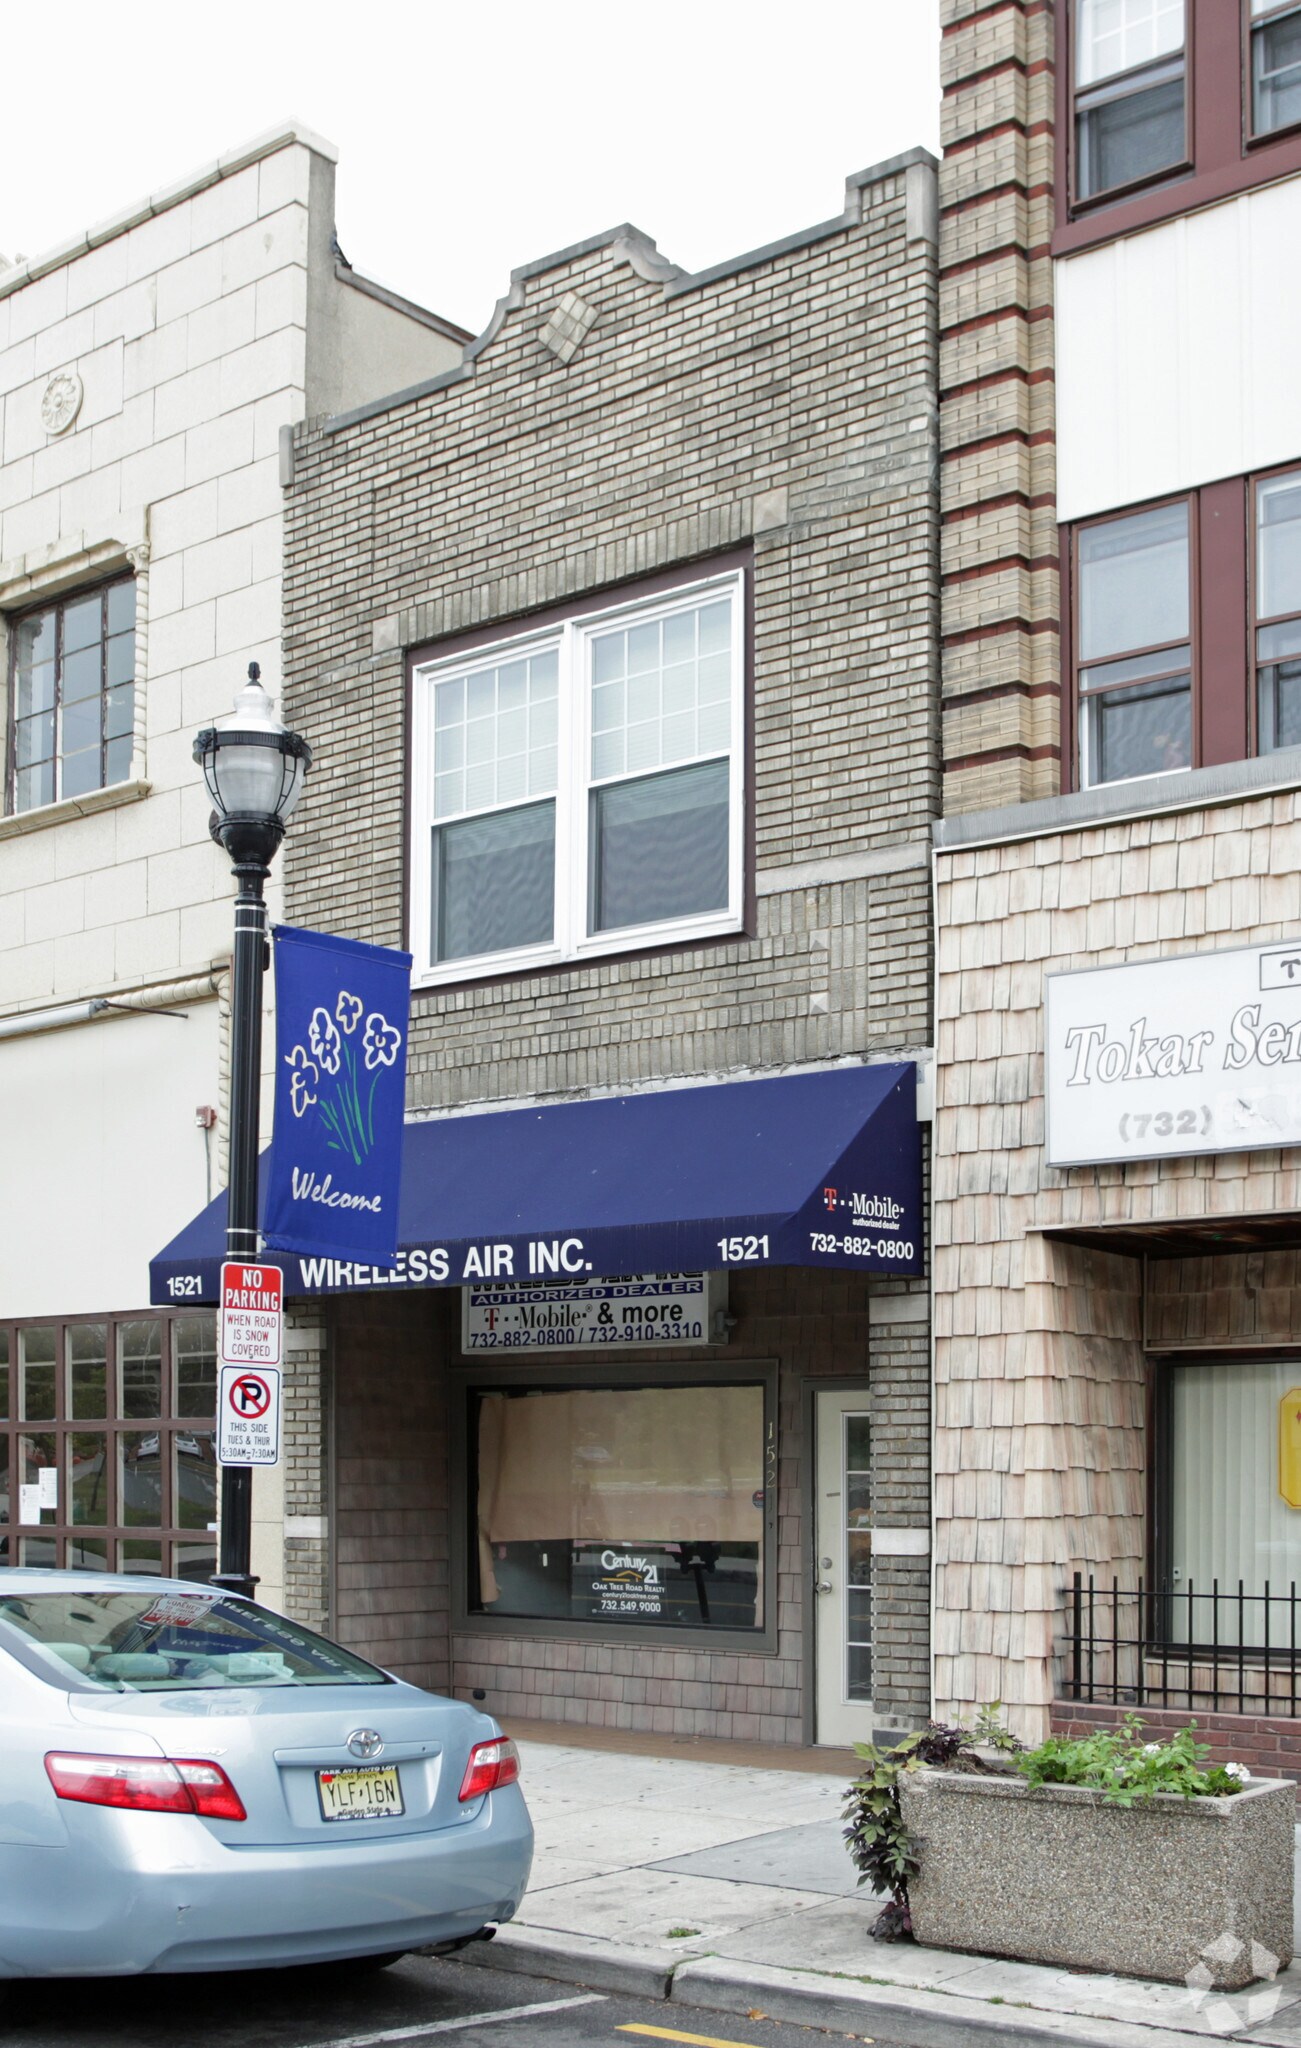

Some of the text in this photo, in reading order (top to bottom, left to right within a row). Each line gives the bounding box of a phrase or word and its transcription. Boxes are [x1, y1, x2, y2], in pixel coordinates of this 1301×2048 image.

[1065, 1017, 1214, 1088] Tokar
[1119, 1104, 1213, 1143] (732)
[292, 1166, 382, 1213] Welcome
[852, 1217, 900, 1231] authorized dealer
[462, 1243, 514, 1279] AIR
[528, 1238, 593, 1275] INC.
[717, 1234, 770, 1262] 1521
[809, 1232, 914, 1260] 732-882-0800
[166, 1275, 203, 1297] 1521
[242, 1269, 263, 1289] NO
[225, 1288, 278, 1311] PARKING
[475, 1287, 606, 1306] AUTHORIZED
[613, 1281, 701, 1298] DEALER
[227, 1313, 277, 1329] WHEN ROAD
[597, 1302, 614, 1326] &
[622, 1303, 683, 1324] more
[233, 1329, 269, 1342] IS SNOW
[470, 1327, 575, 1348] 732-882-0800
[588, 1321, 702, 1343] 732-910-3310
[231, 1343, 271, 1357] COVERED
[230, 1422, 269, 1433] THIS SIDE
[228, 1434, 244, 1445] TUES
[254, 1436, 271, 1446] THUR
[601, 1549, 659, 1584] Century 21
[609, 1582, 624, 1592] TREE
[625, 1583, 643, 1592] ROAD
[644, 1584, 665, 1594] REALTY
[600, 1599, 661, 1613] 732.549.9000
